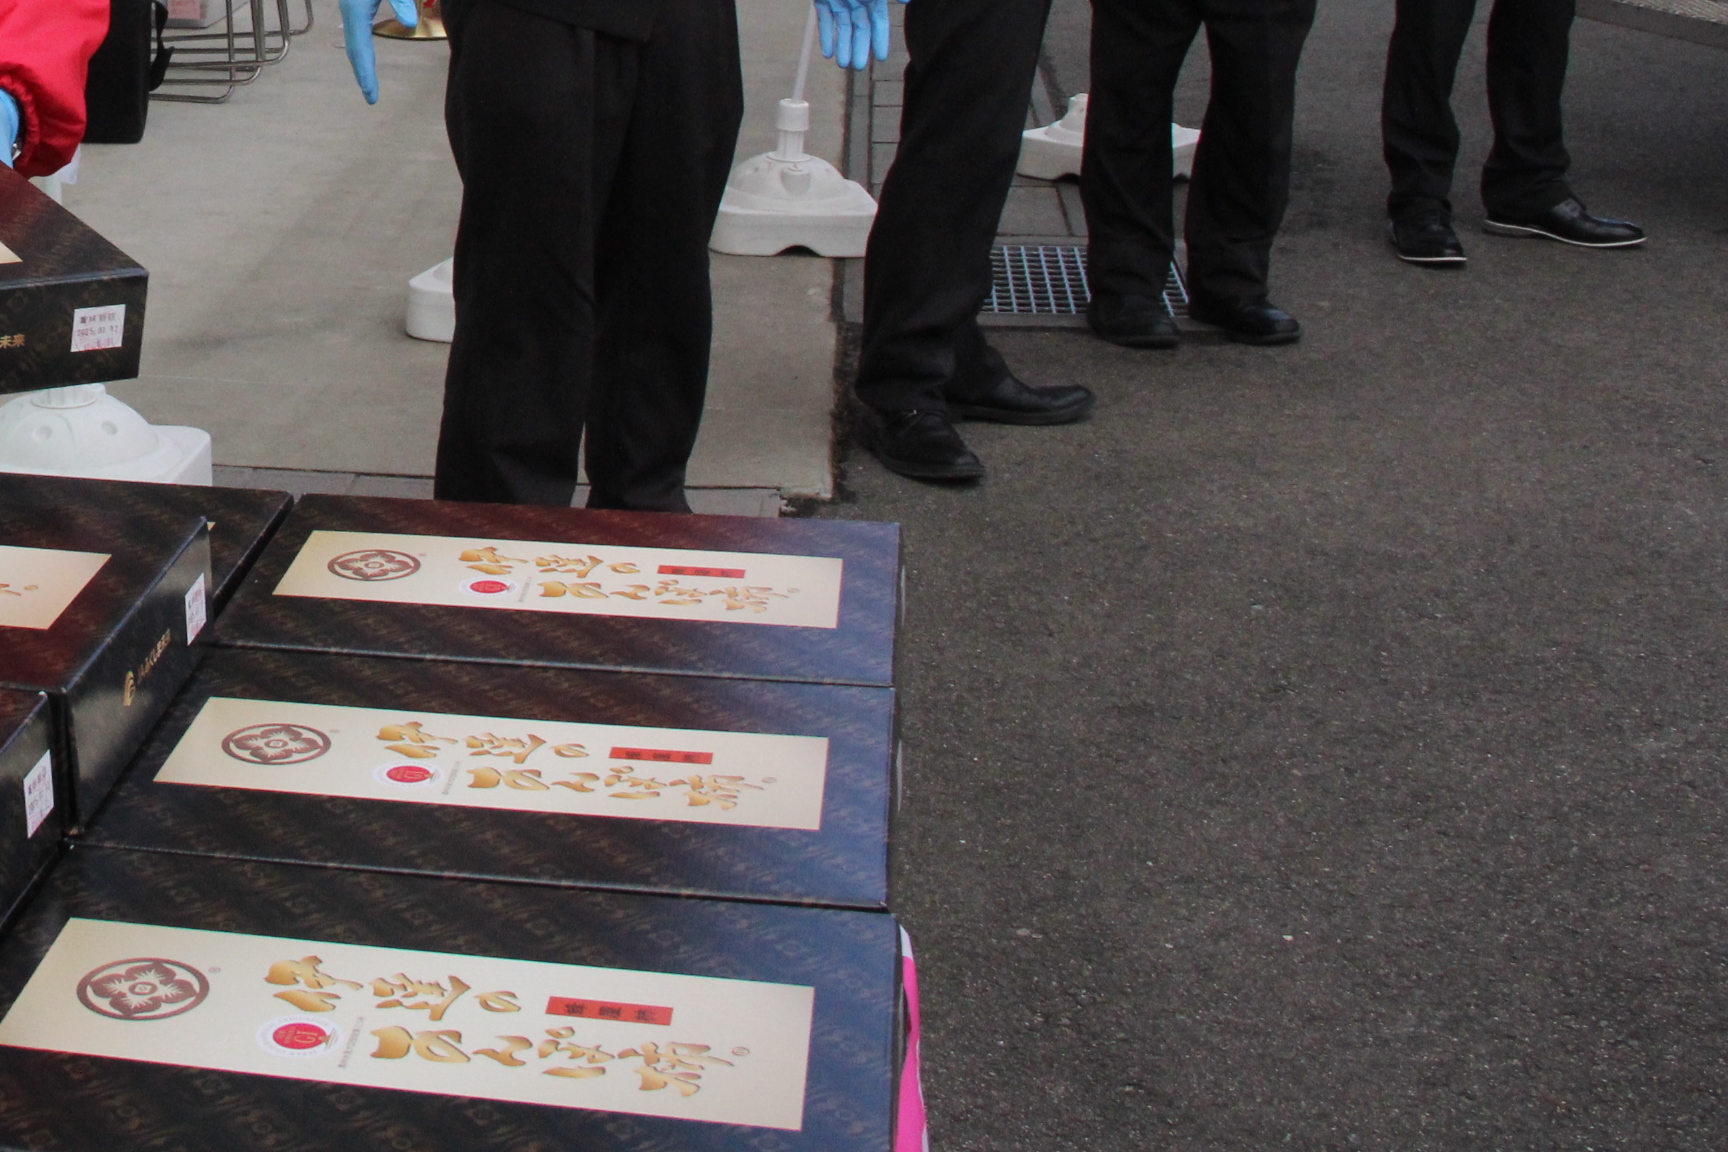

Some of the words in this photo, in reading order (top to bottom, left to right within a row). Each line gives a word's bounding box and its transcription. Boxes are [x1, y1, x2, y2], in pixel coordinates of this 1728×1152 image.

[264, 954, 526, 1023] 伊達の
[370, 1025, 734, 1099] あんぽ柿
